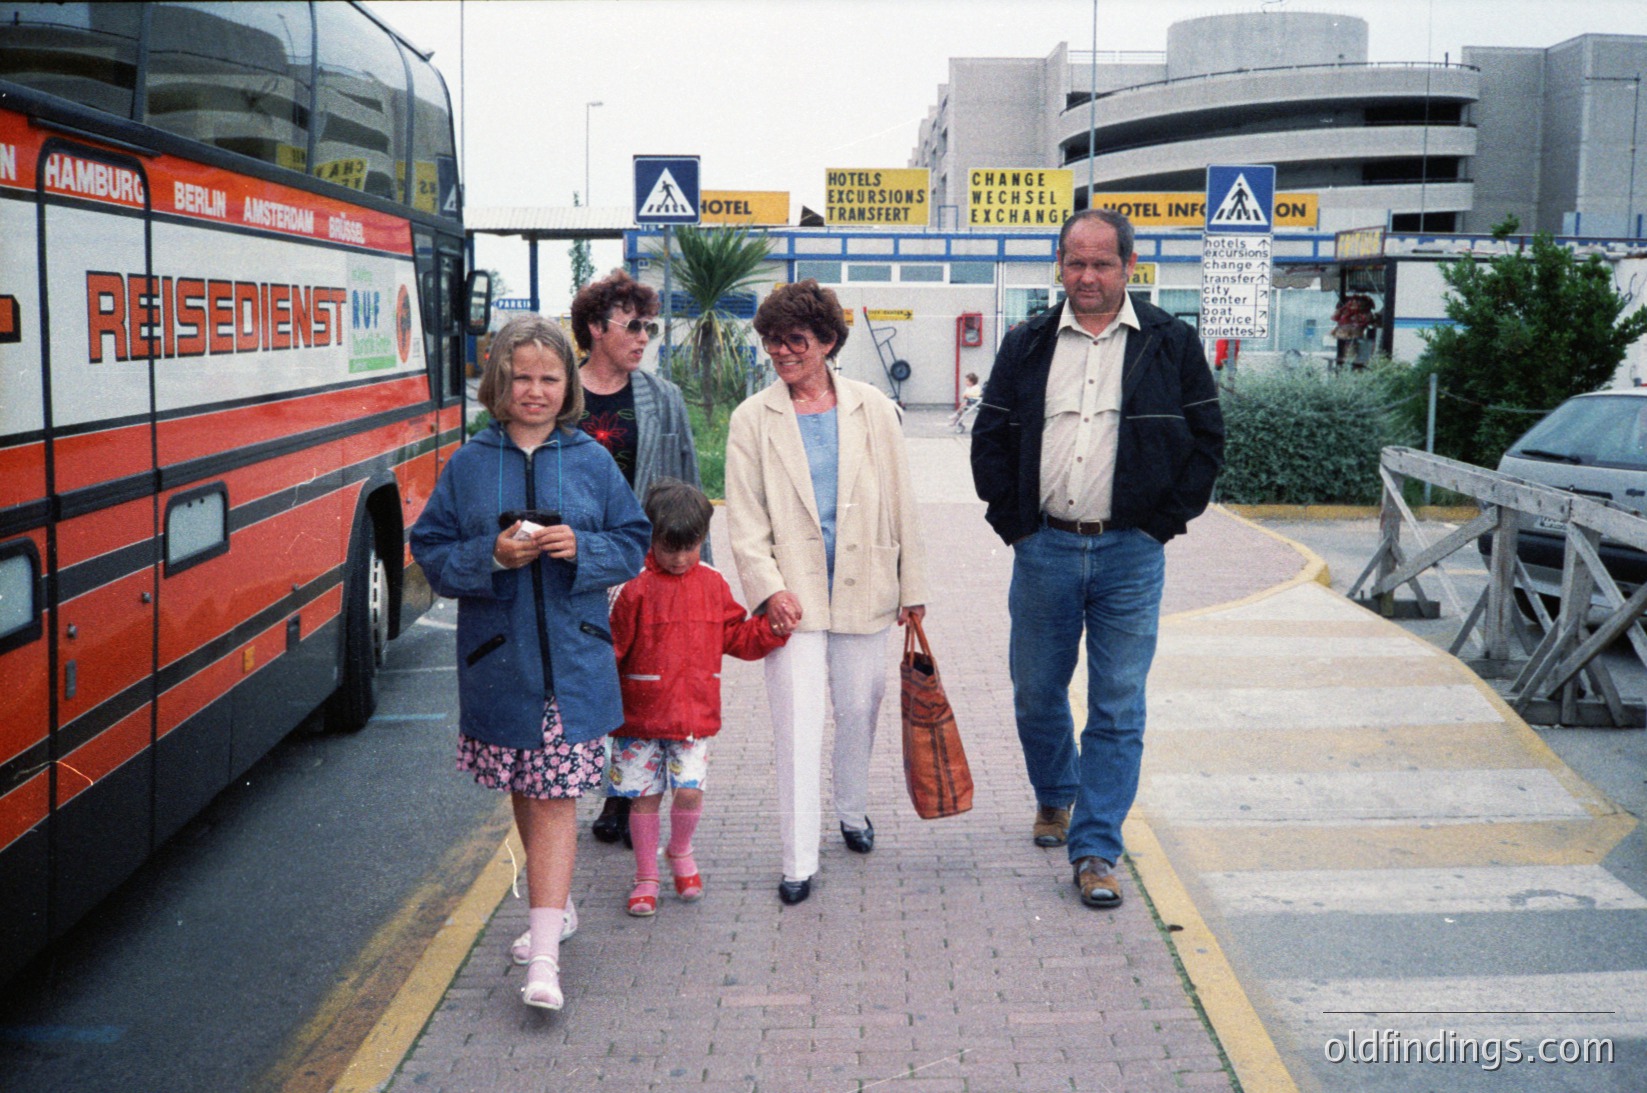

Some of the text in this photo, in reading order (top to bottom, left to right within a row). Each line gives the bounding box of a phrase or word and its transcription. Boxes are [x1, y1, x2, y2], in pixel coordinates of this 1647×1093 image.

[827, 172, 882, 187] HOTELS
[971, 172, 1045, 186] CHANGE
[45, 154, 145, 203] HAMBURG
[174, 181, 226, 218] BERLIN
[243, 196, 314, 234] AMSTERDAM
[827, 189, 925, 204] EXCURSIONS
[972, 190, 1057, 204] WECHSEL
[827, 206, 911, 221] TRANSFERT
[971, 208, 1070, 223] EXCHANGE
[1205, 238, 1247, 249] hotels
[1205, 249, 1269, 258] excursions
[1204, 260, 1253, 272] change
[1204, 273, 1256, 283] transfer
[1203, 286, 1230, 296] city
[1203, 295, 1248, 304] center
[86, 270, 347, 363] REISEDIENST
[1202, 306, 1233, 316] boat
[1202, 315, 1253, 324] service
[1202, 326, 1255, 336] toilettes
